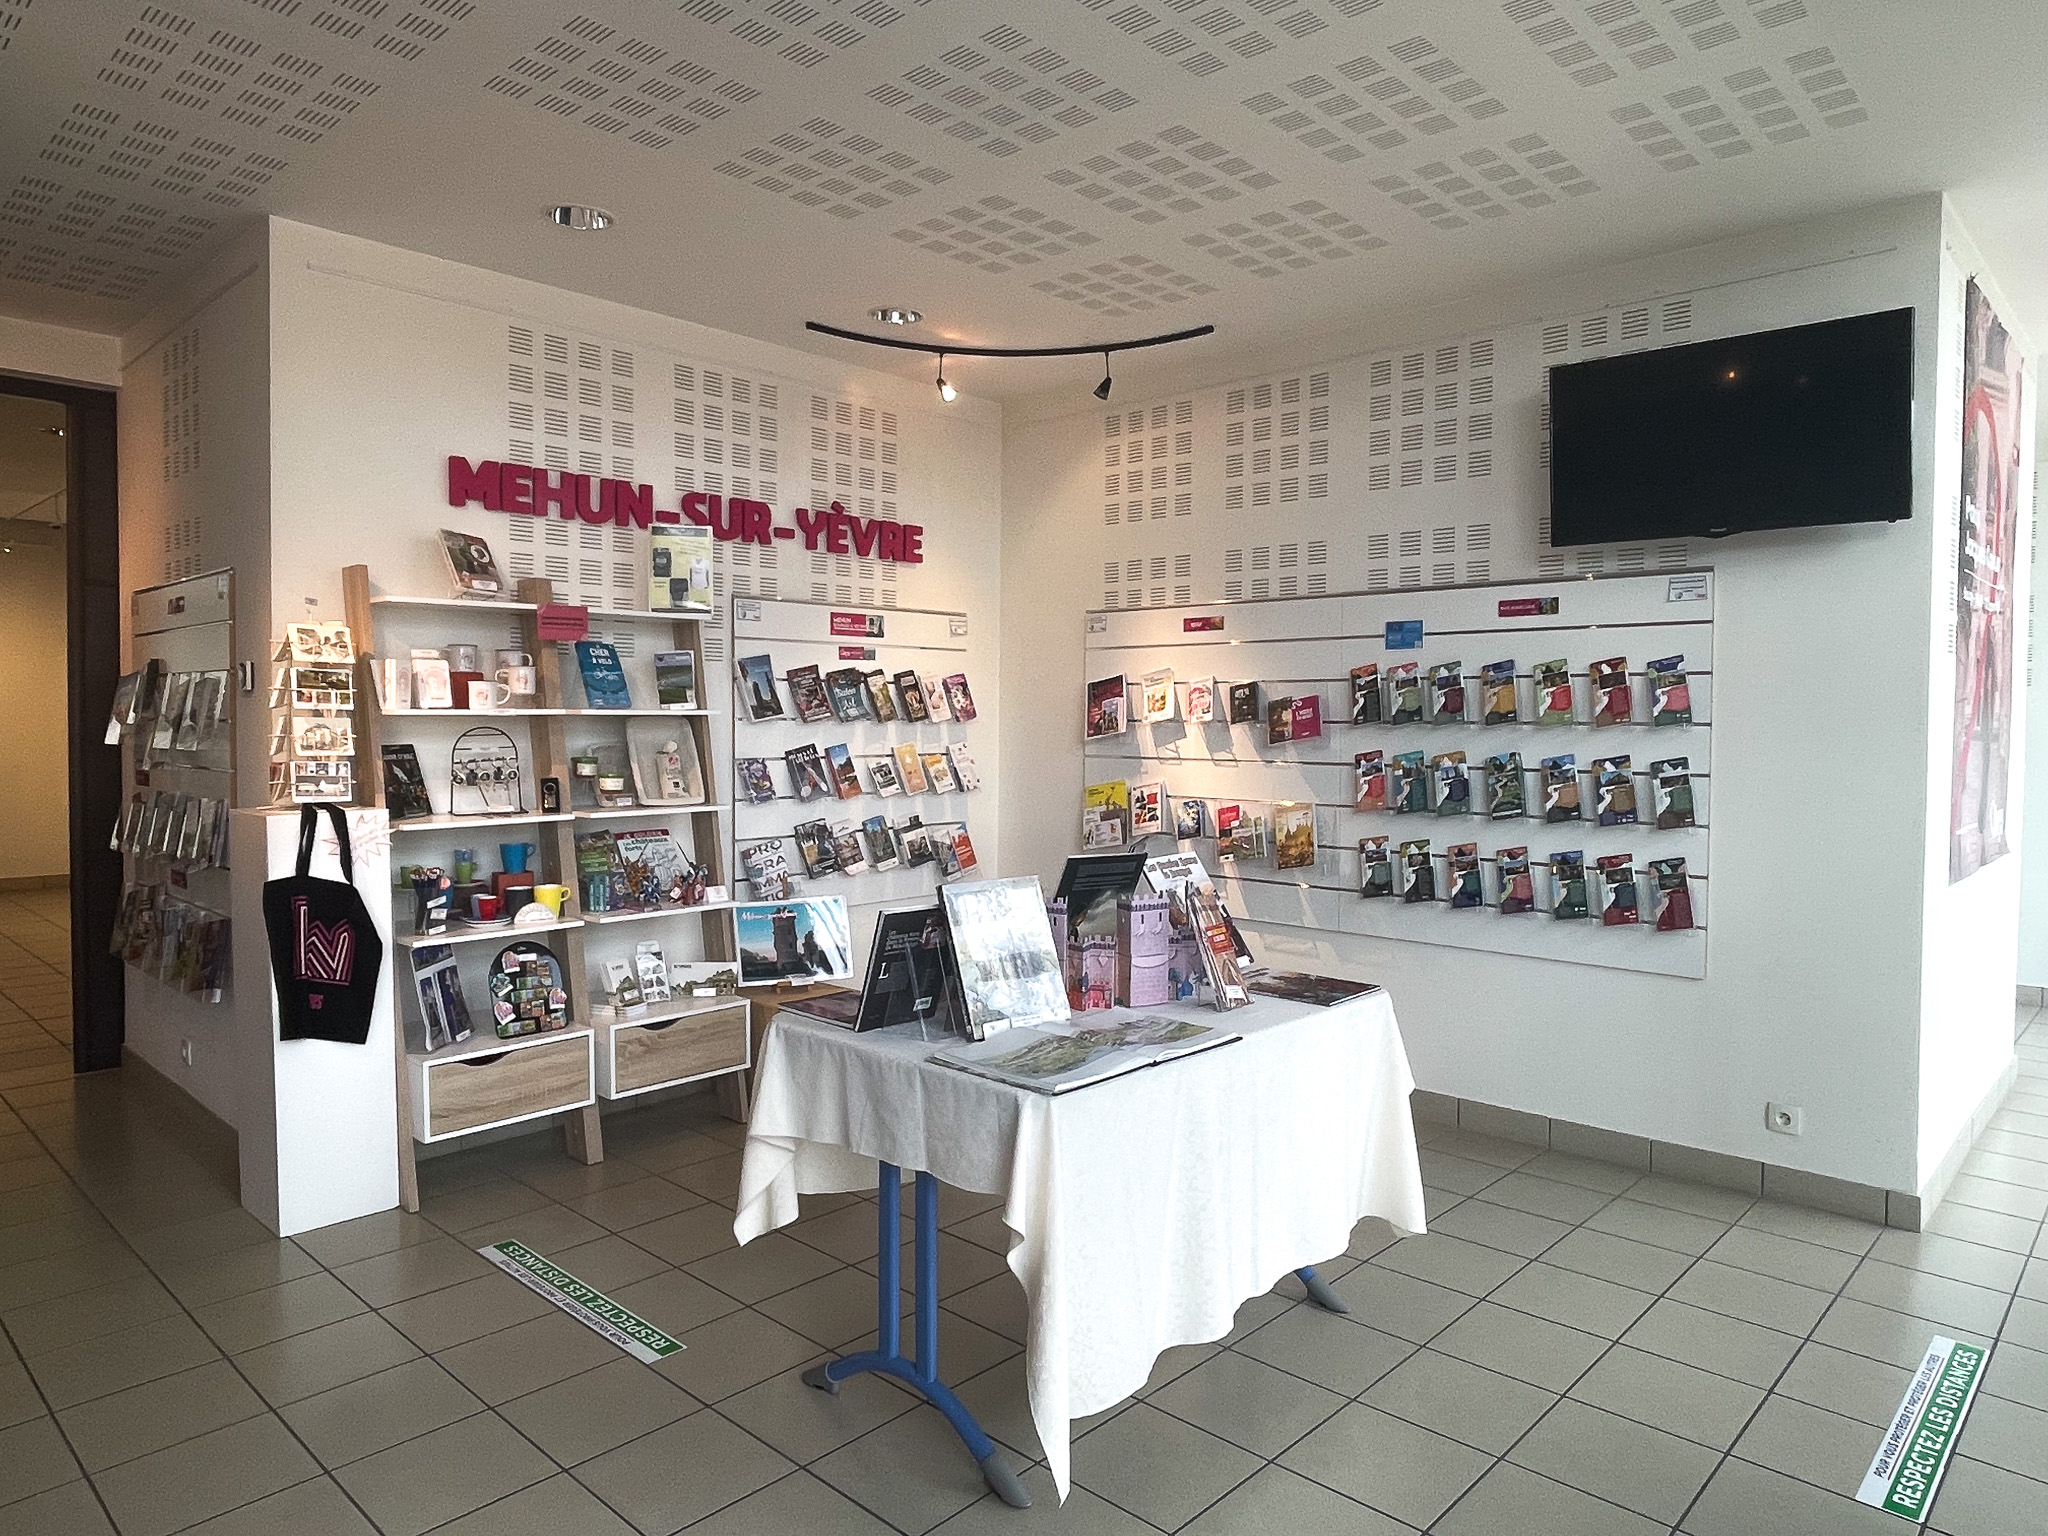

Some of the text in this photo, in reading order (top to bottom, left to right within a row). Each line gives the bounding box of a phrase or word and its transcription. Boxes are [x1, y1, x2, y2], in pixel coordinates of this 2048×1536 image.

[447, 455, 924, 563] MEHUN-SUR-YÈVRE
[749, 839, 782, 856] PRO
[878, 962, 889, 979] L
[500, 1244, 671, 1349] RESPECTEZ LES DISTANCES
[1874, 1459, 1890, 1478] POUR
[1883, 1441, 1899, 1460] VOUS
[1892, 1349, 1978, 1509] RESPECTEZ LES DISTANCES
